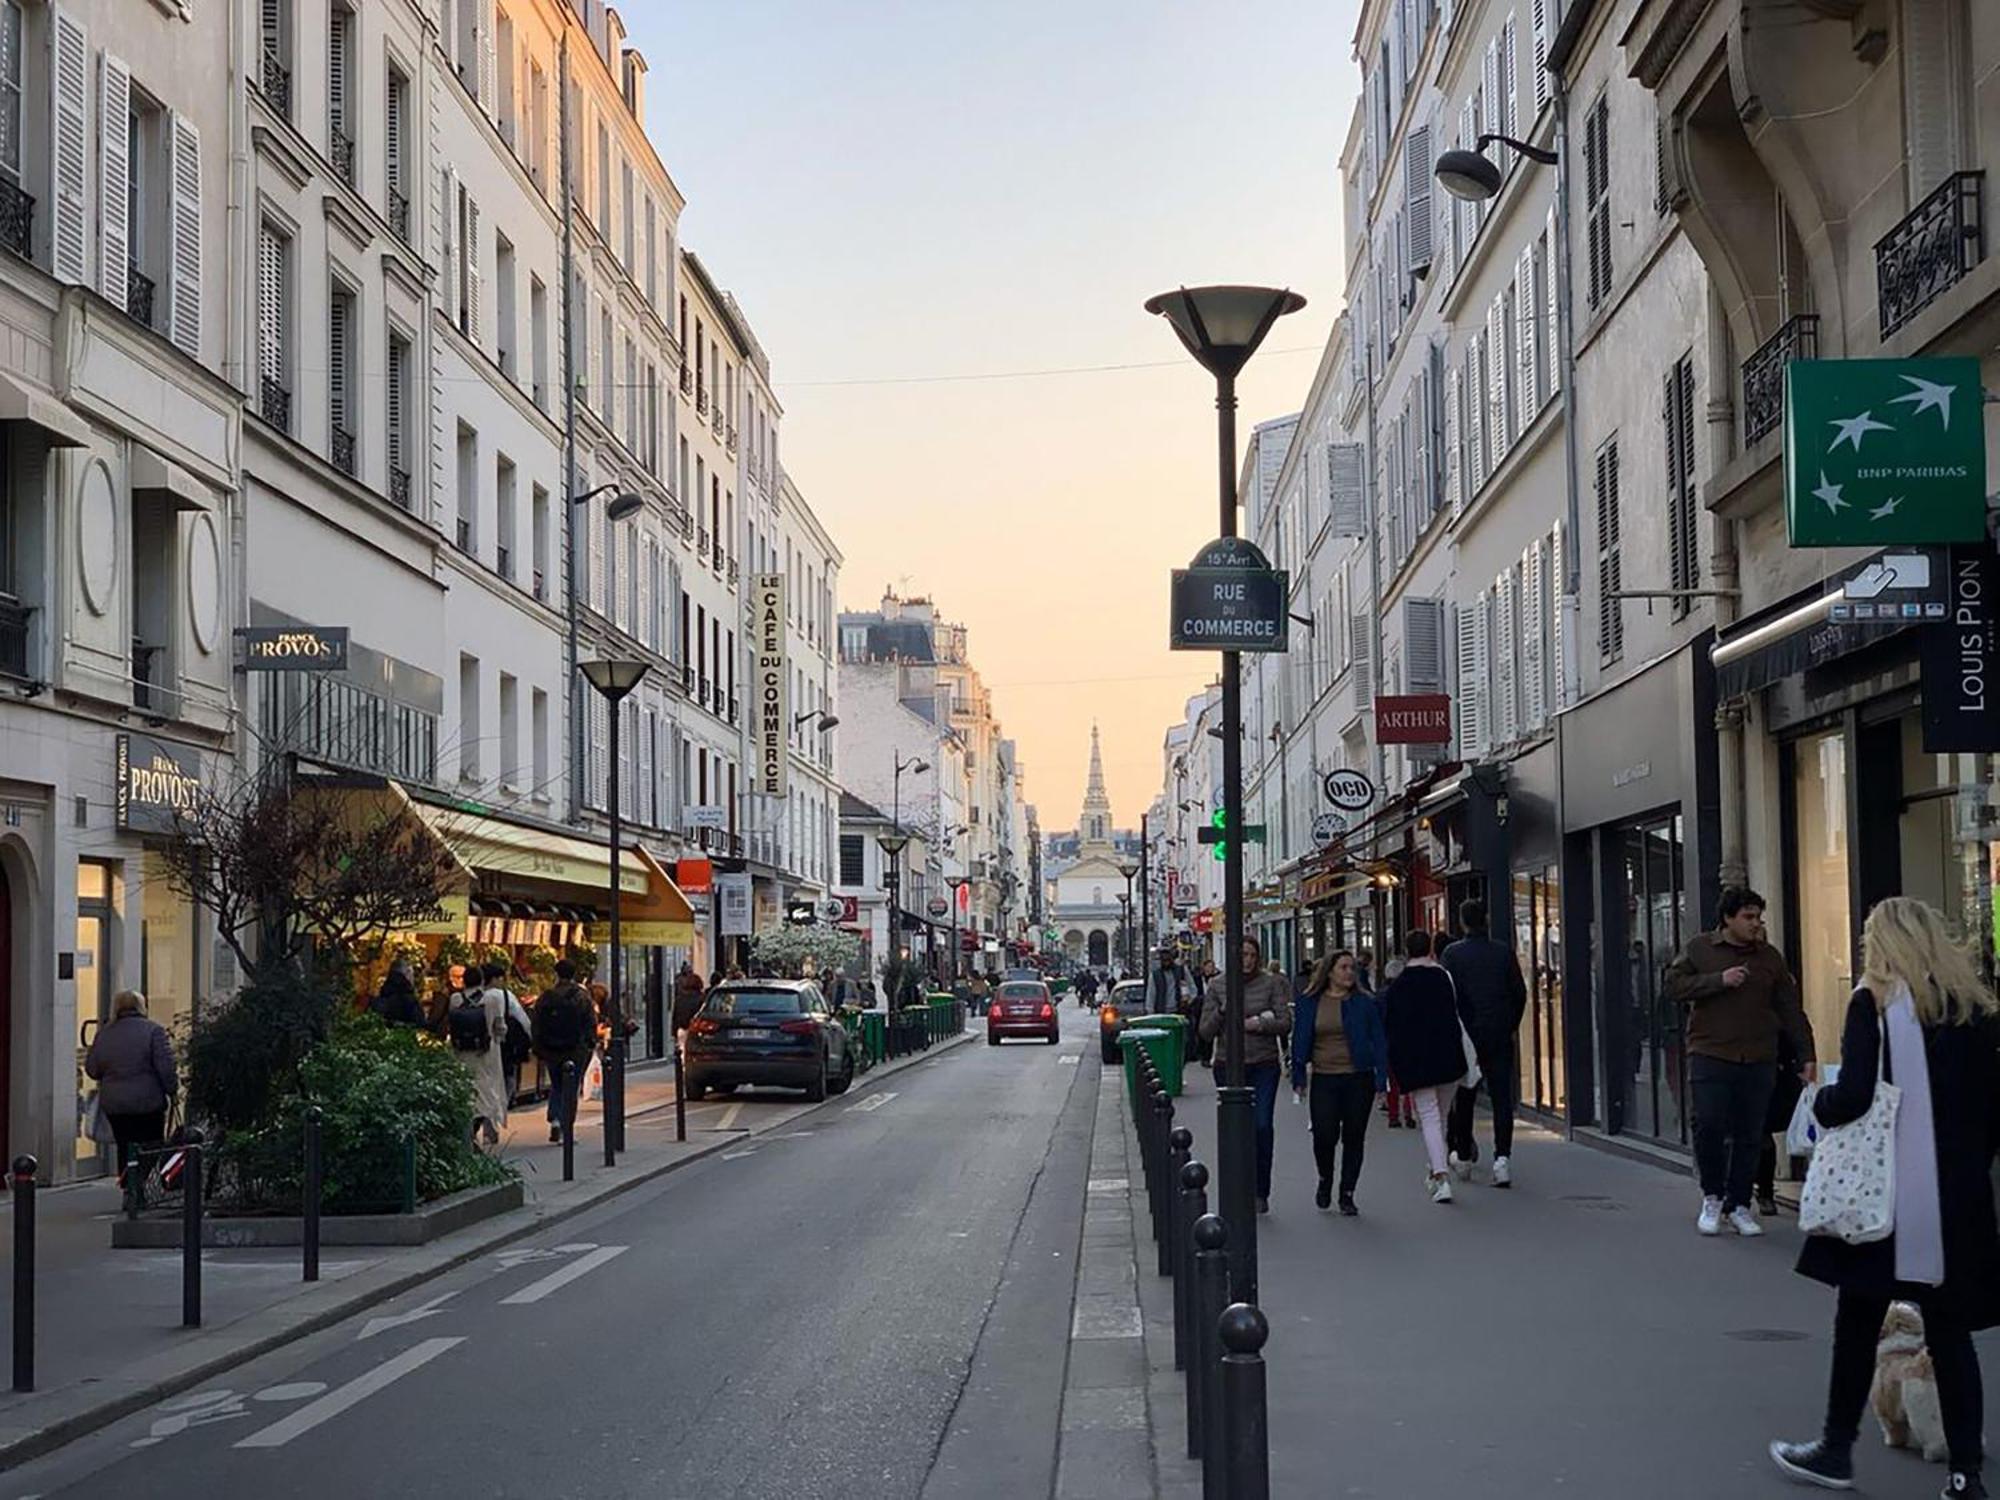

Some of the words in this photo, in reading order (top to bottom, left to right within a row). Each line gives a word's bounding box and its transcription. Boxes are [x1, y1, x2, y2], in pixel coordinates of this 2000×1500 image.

[1857, 468, 1892, 479] BNP
[1896, 465, 1967, 478] PARIBAS
[761, 577, 779, 588] LE
[1213, 584, 1245, 600] RUE
[1957, 560, 1981, 625] PION
[1222, 605, 1235, 616] DU
[1183, 620, 1275, 636] COMMERCE
[279, 634, 316, 642] FRANCK
[249, 641, 340, 657] PROVOST
[760, 657, 781, 668] DU
[1959, 634, 1984, 710] LOUIS
[1380, 711, 1446, 728] ARTHUR
[764, 672, 779, 793] COMMERCE
[130, 767, 199, 808] PROVOST
